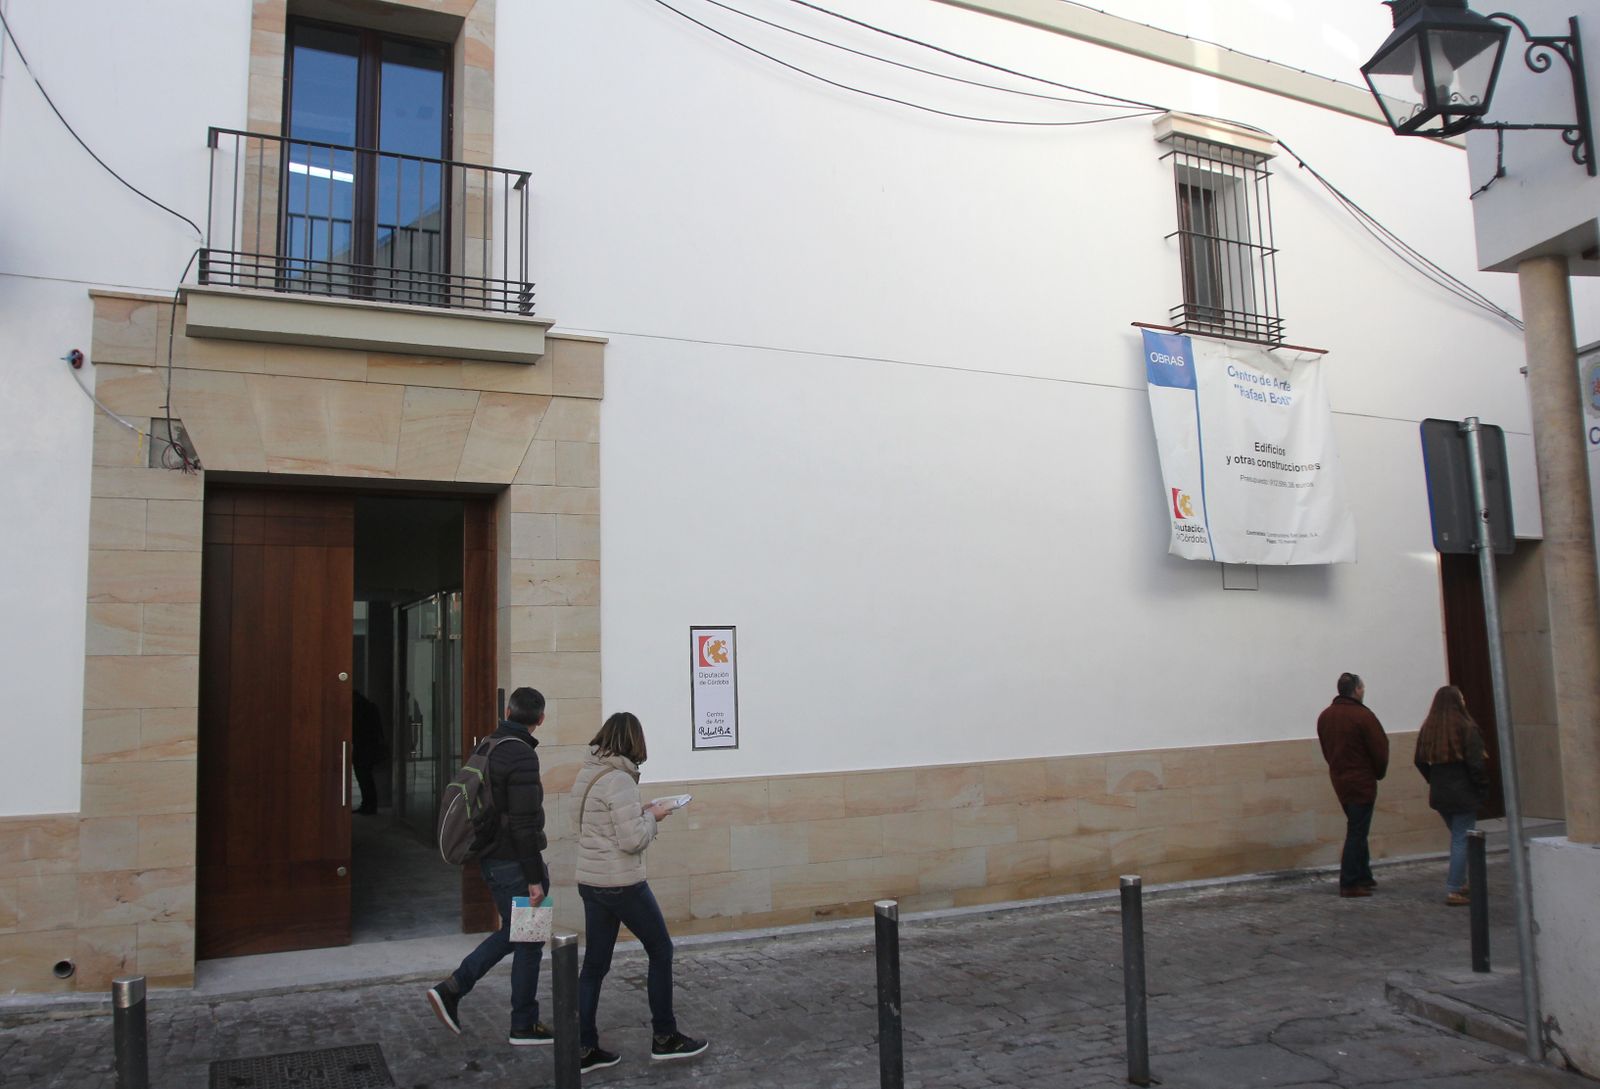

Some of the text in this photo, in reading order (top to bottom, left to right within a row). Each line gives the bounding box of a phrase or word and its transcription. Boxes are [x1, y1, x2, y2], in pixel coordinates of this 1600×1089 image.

[1150, 351, 1184, 367] OBRAS
[1259, 375, 1271, 386] de
[1254, 442, 1286, 456] Edificios
[1226, 455, 1321, 472] y otras construcciones
[698, 671, 730, 679] Diputación
